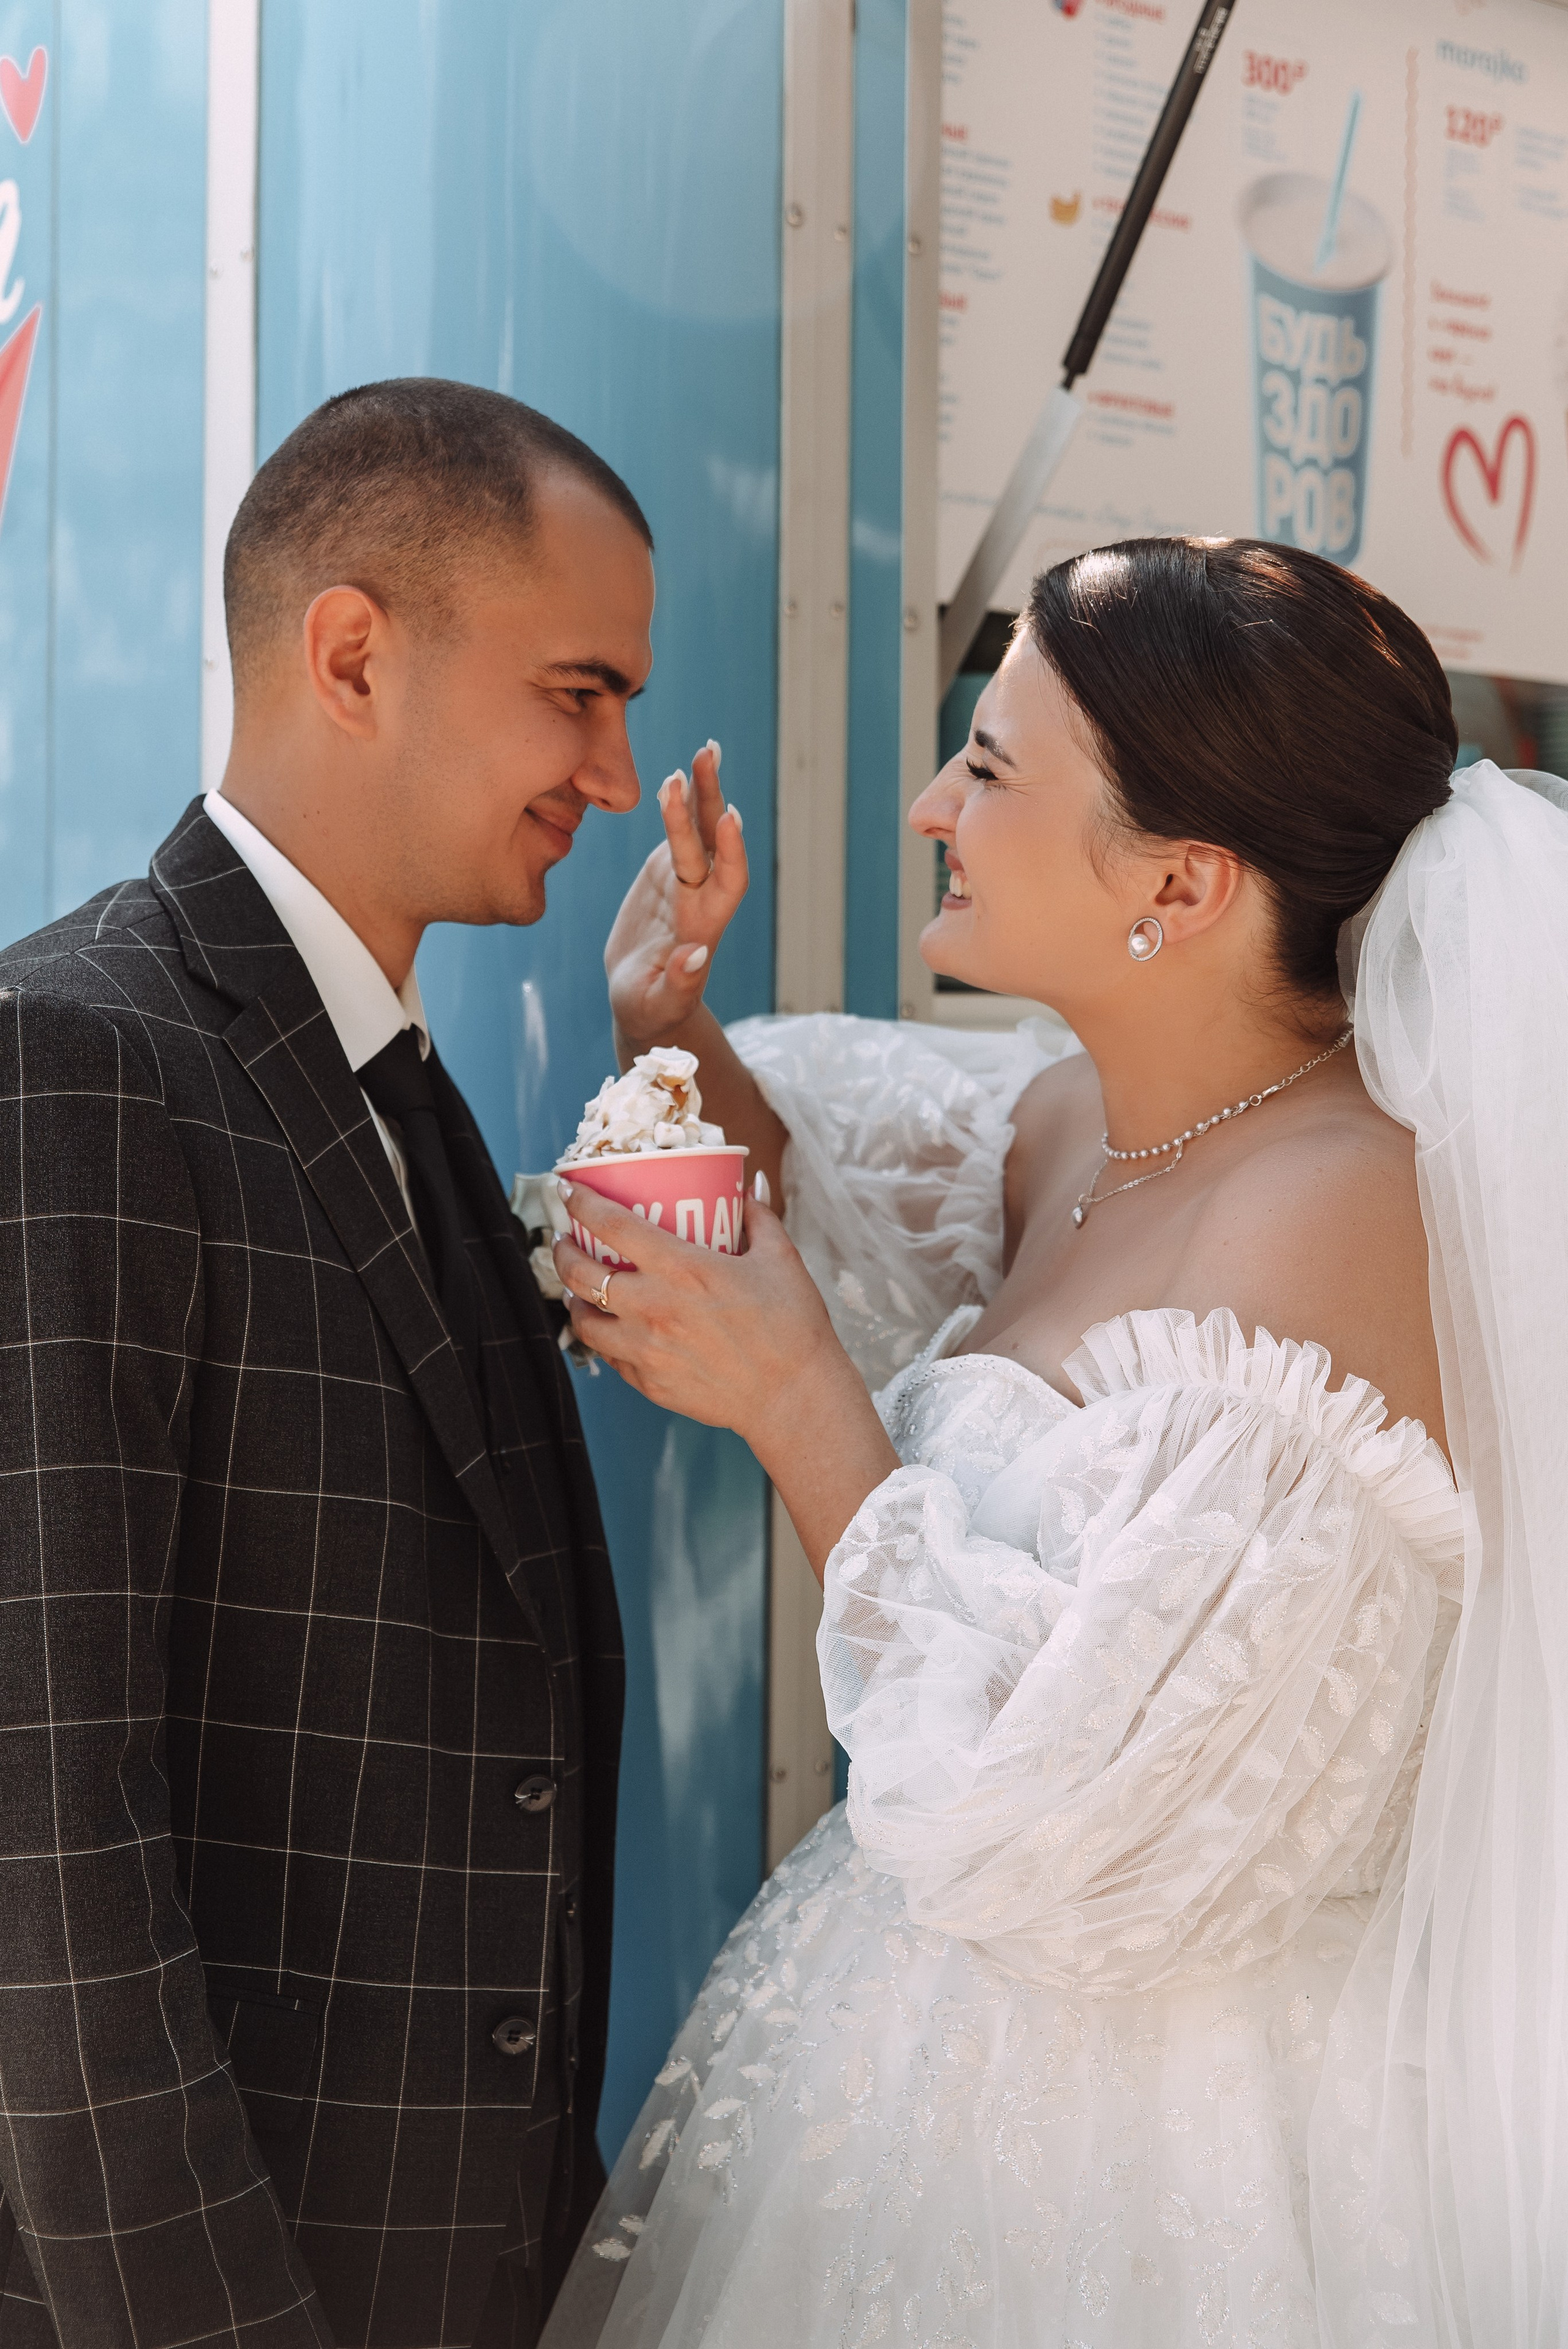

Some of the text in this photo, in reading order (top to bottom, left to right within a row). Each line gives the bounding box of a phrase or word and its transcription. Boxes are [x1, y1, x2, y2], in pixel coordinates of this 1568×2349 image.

[1257, 293, 1366, 380] БУДЬ
[1262, 370, 1362, 468] ЗДО
[1262, 453, 1357, 554] РОВ
